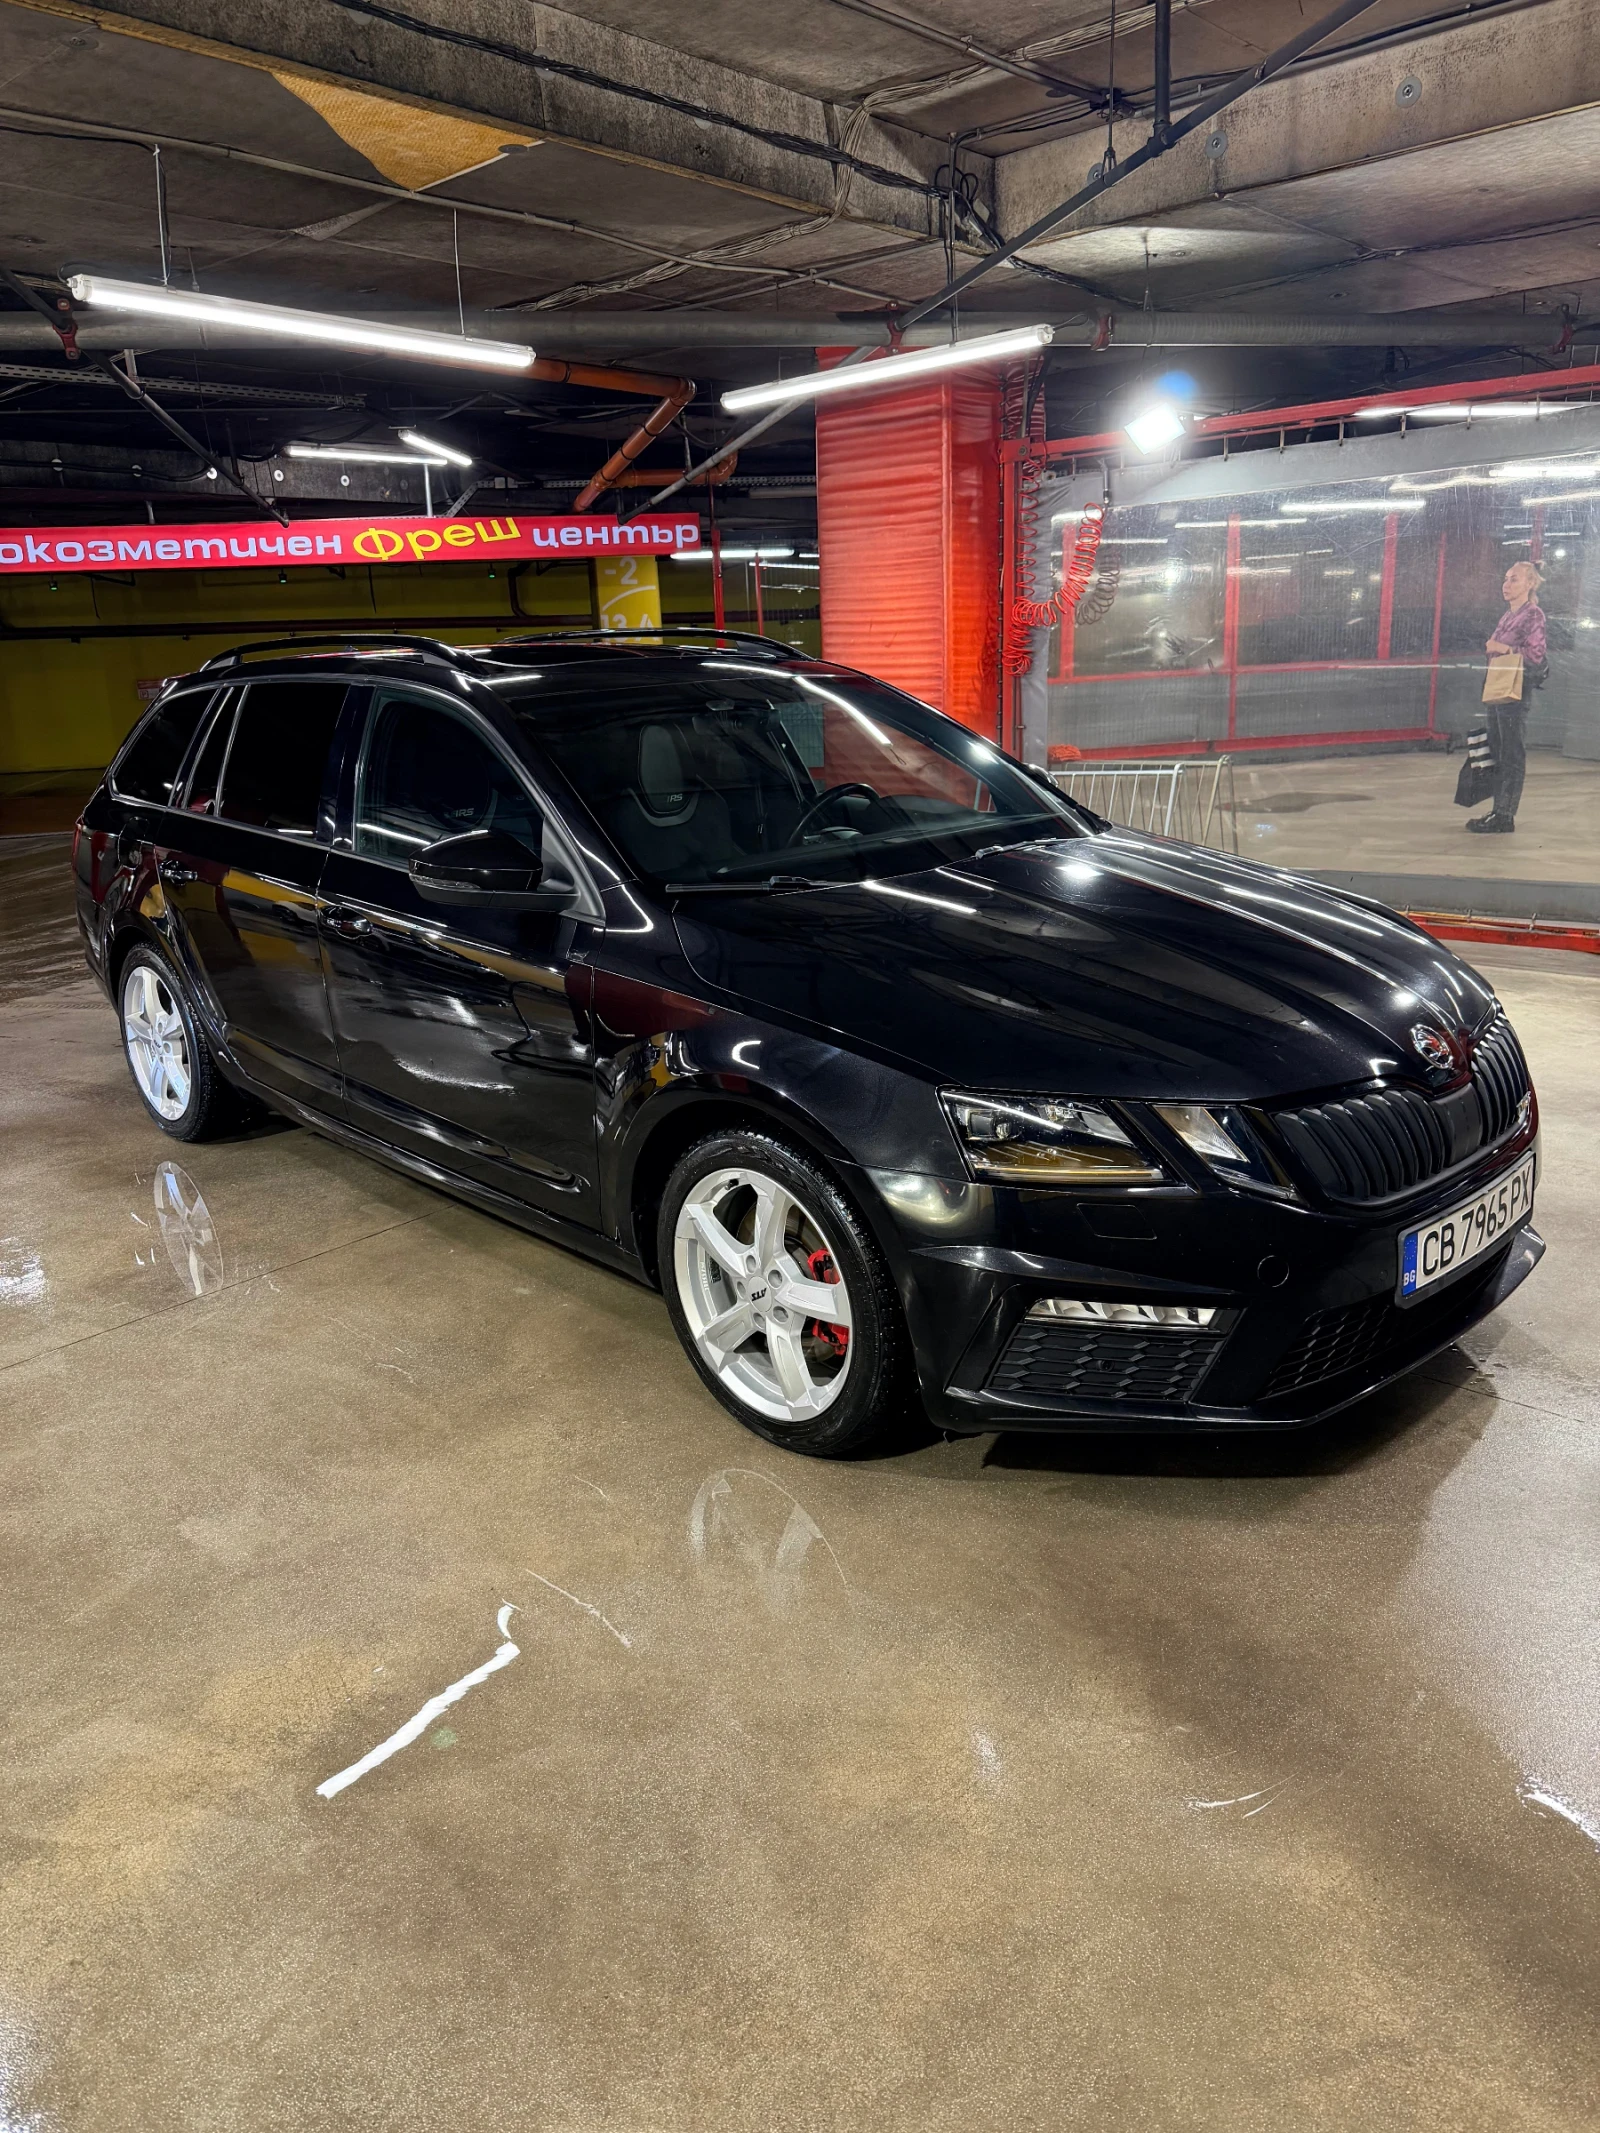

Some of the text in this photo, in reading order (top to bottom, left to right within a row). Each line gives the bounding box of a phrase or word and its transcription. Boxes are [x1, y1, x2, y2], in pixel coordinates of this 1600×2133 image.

[352, 517, 521, 560] Фреш
[533, 523, 699, 548] център
[1422, 1222, 1455, 1276] CB
[1459, 1186, 1508, 1258] 7965
[1403, 1269, 1416, 1286] BG
